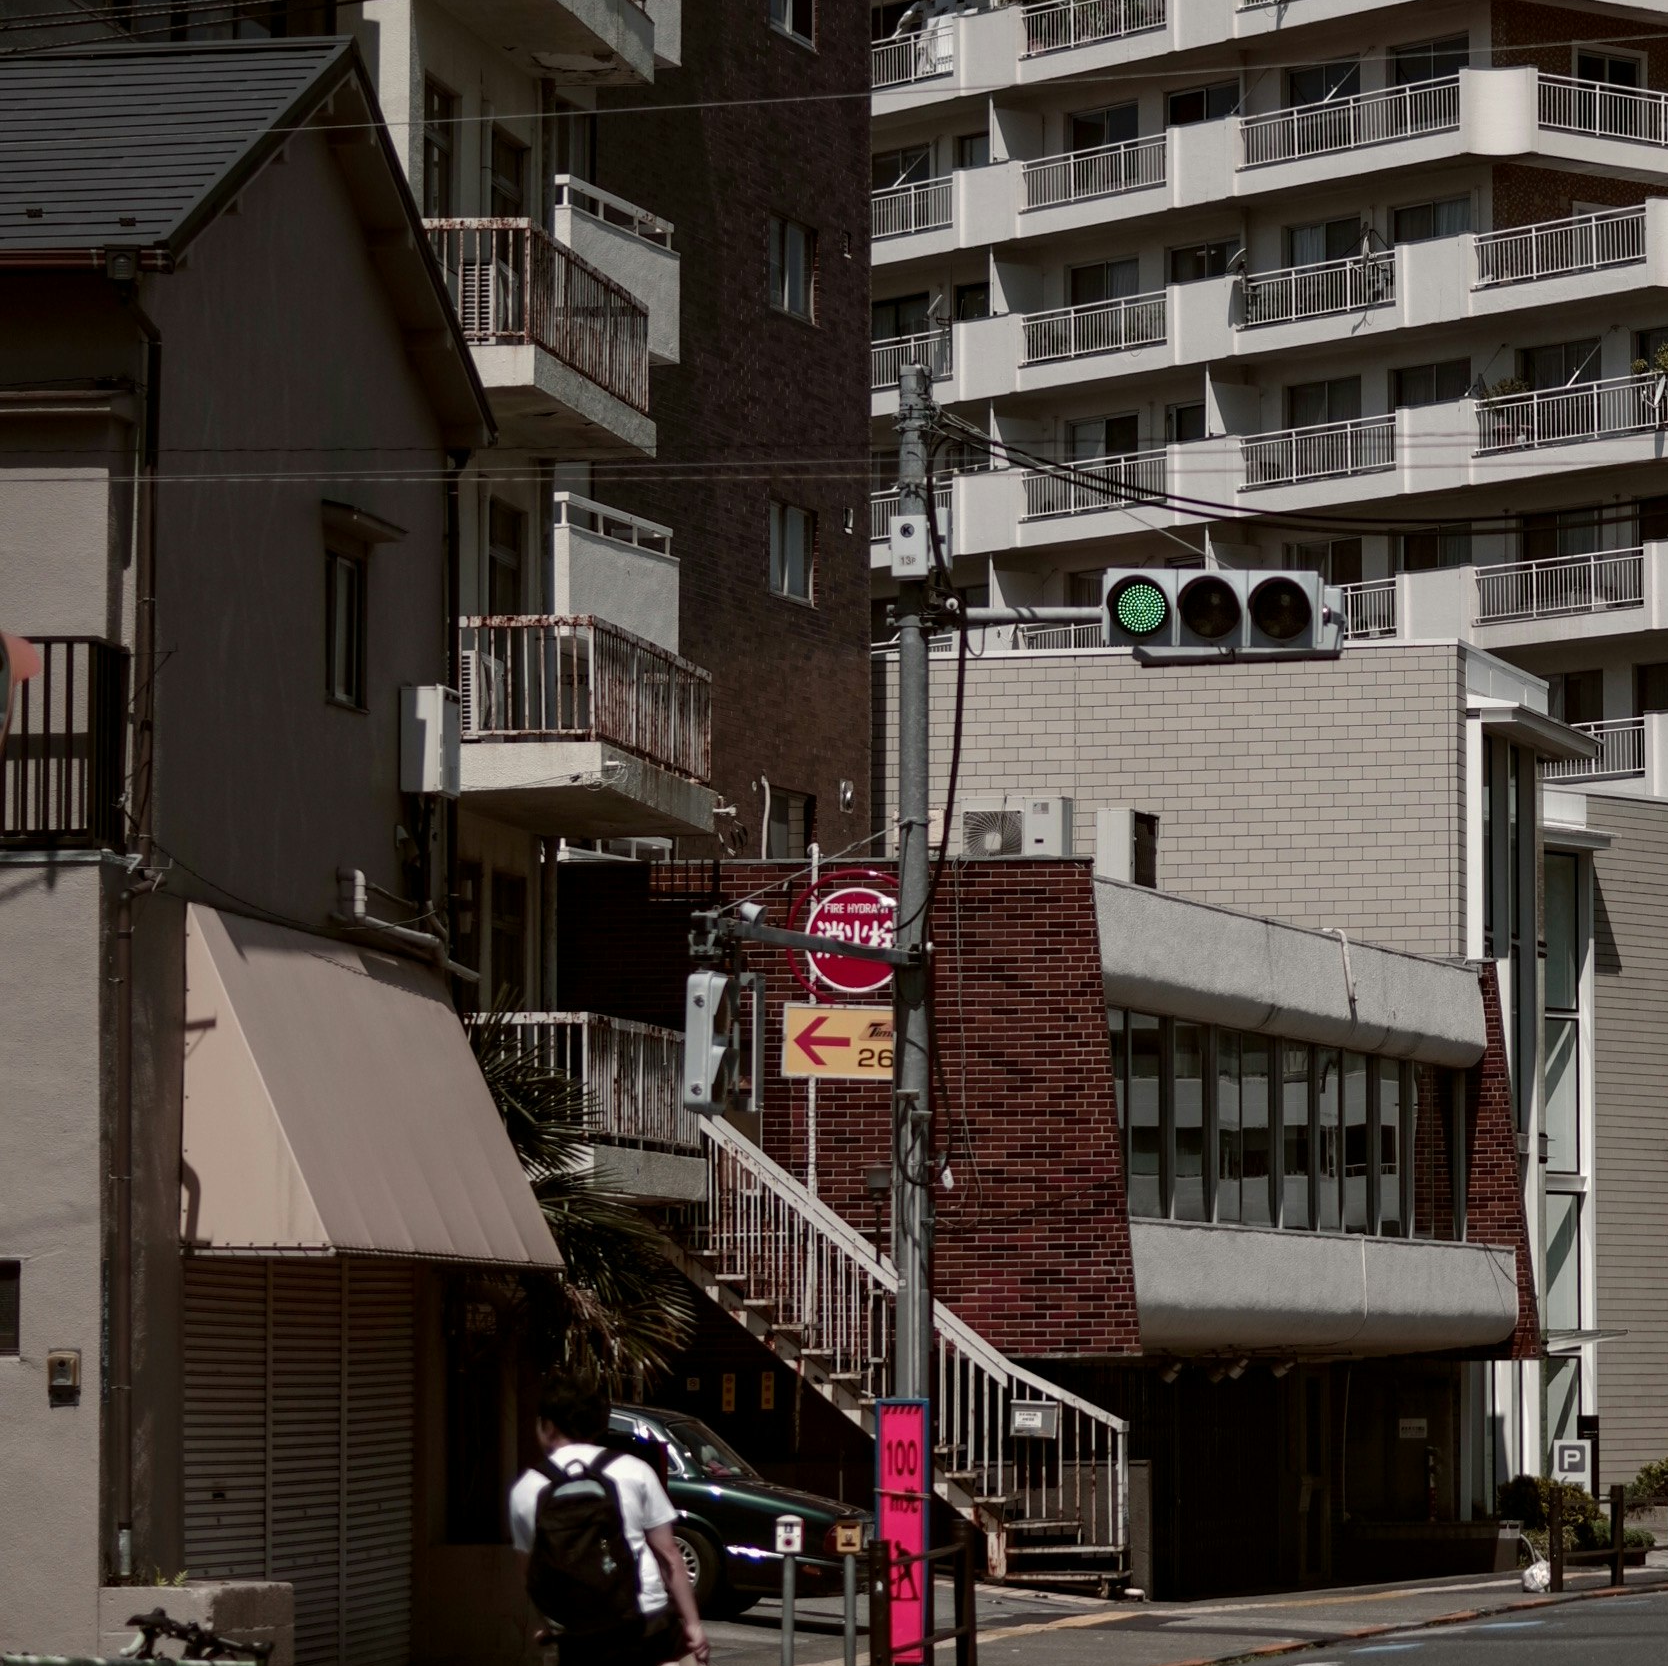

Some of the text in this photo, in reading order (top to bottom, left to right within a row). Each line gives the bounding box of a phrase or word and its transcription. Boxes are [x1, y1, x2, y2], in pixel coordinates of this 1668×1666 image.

[824, 903, 845, 914] FIRE
[885, 1439, 918, 1477] 100
[1563, 1449, 1581, 1470] P
